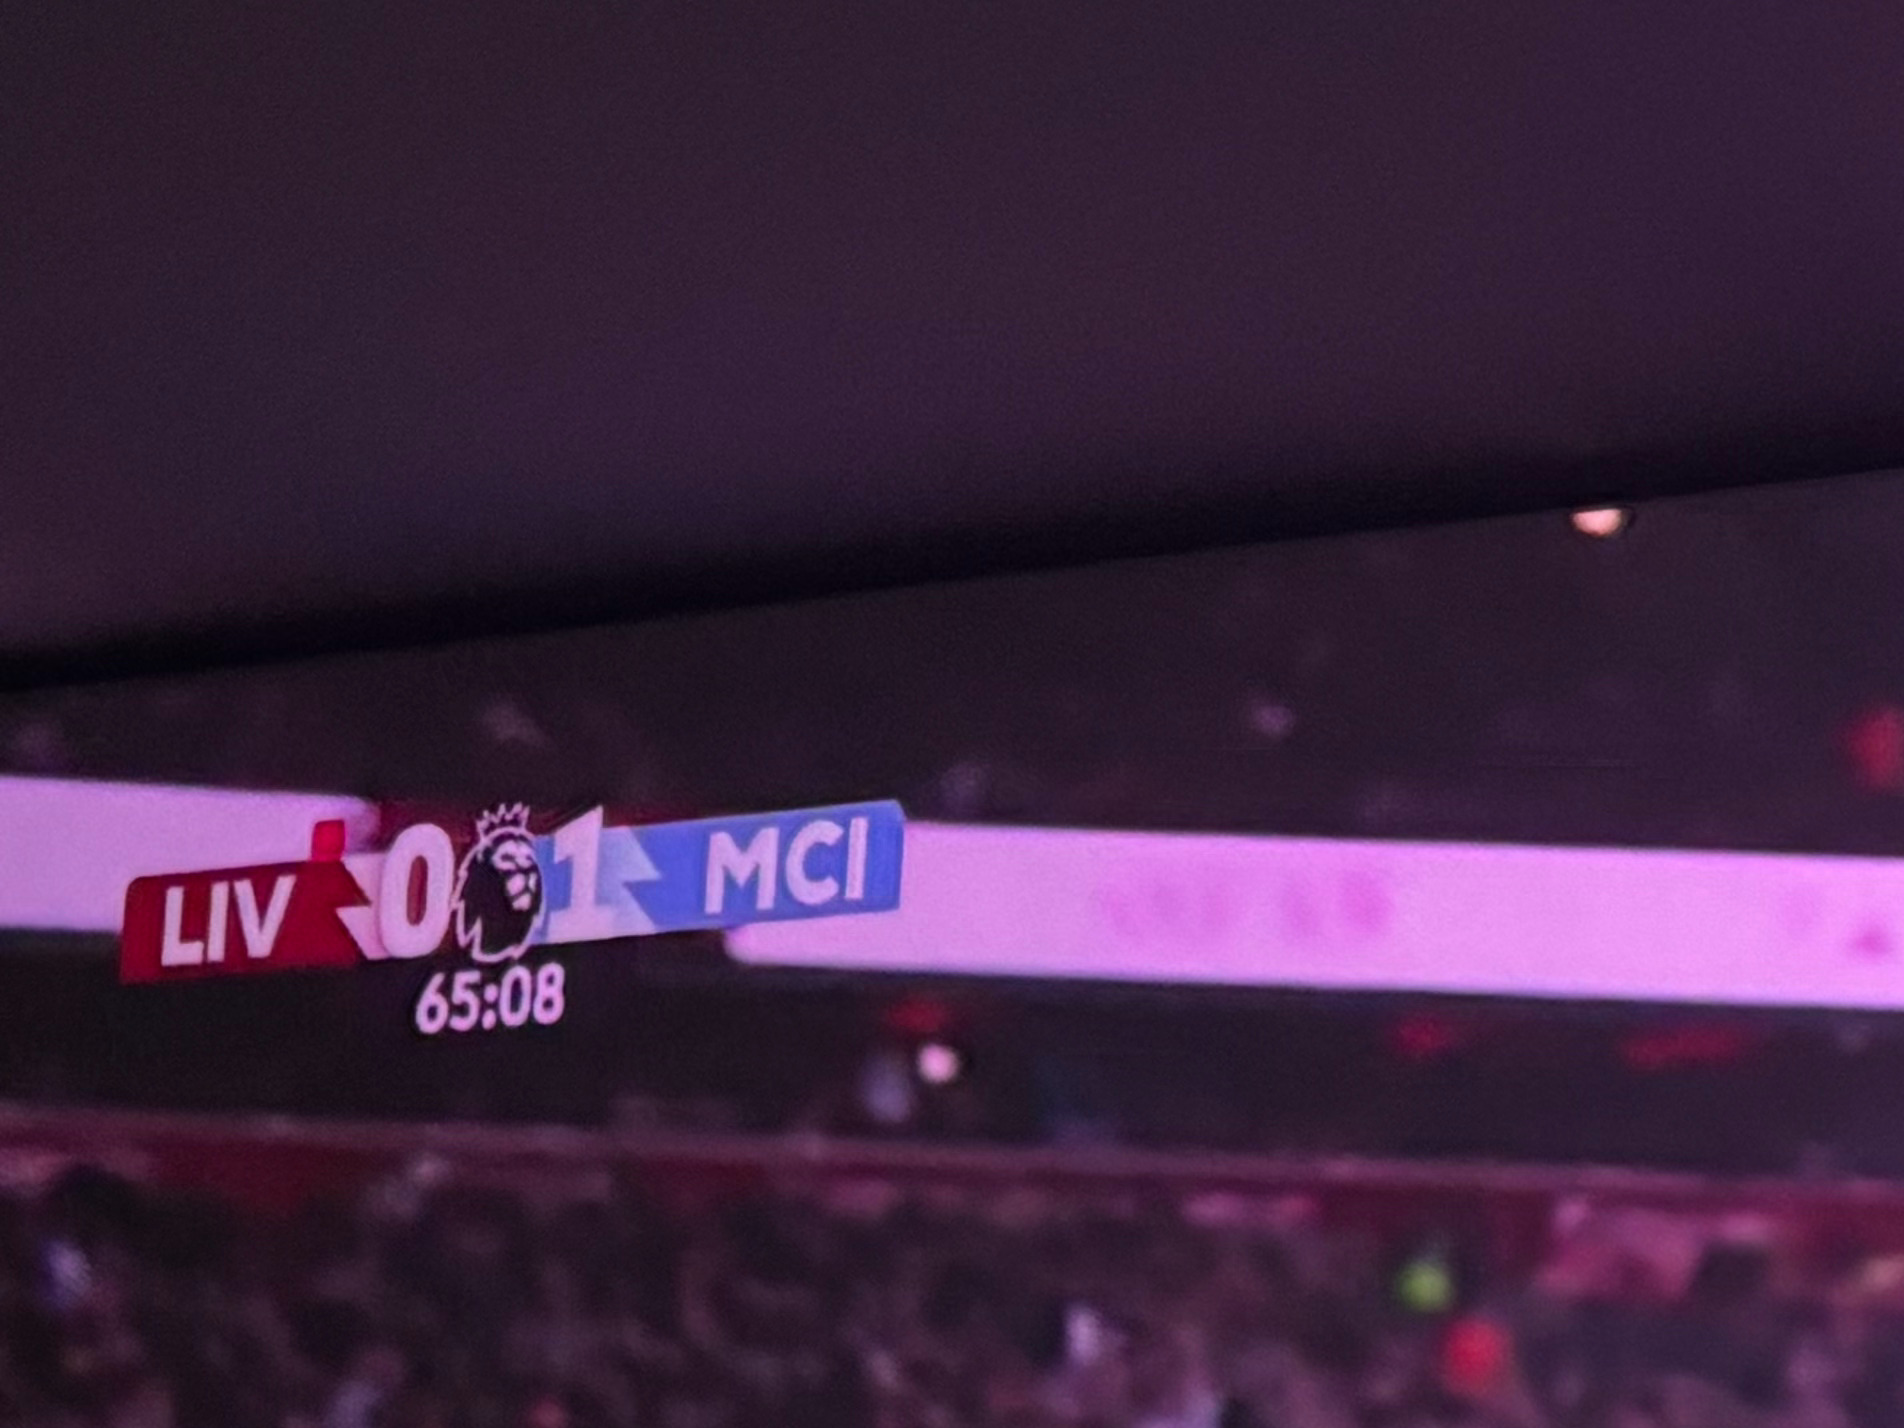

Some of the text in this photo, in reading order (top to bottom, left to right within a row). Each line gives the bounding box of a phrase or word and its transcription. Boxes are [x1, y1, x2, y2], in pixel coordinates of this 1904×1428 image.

[160, 805, 870, 967] LIV 0 1 MCI
[415, 962, 566, 1034] 65:08
